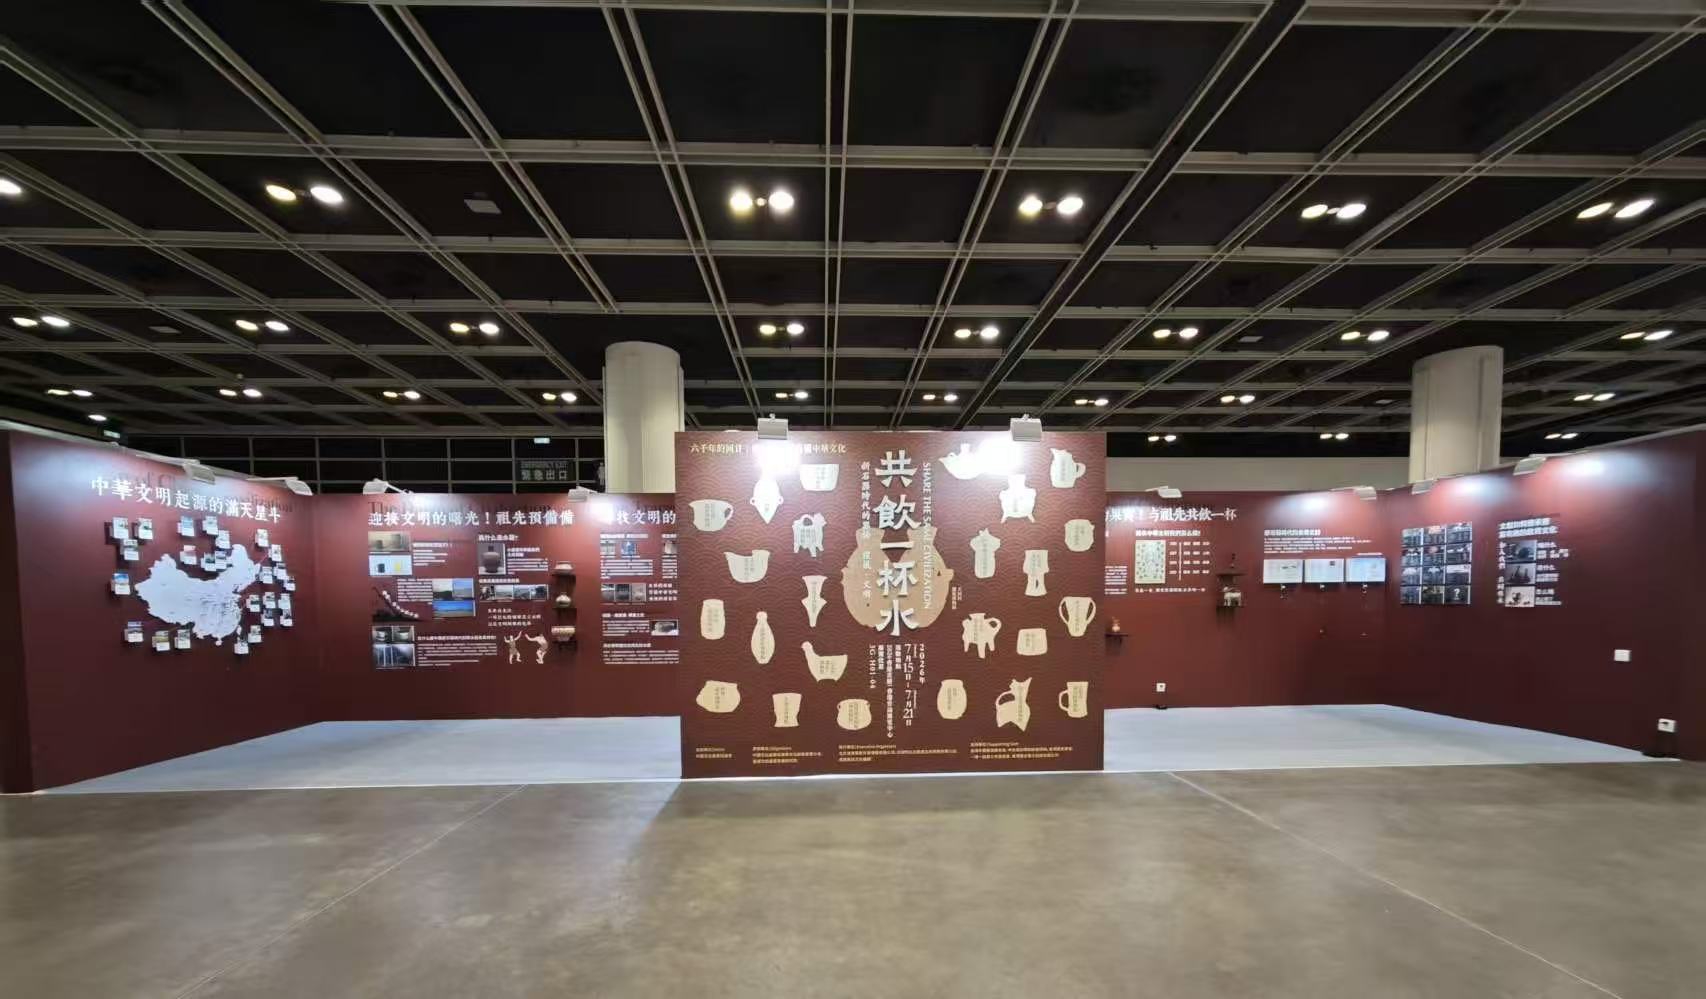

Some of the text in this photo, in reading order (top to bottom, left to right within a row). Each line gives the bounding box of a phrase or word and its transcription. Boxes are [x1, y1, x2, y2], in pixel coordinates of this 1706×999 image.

[923, 462, 932, 494] SHARE
[91, 476, 281, 523] 中華文明起源的滿天星斗
[923, 496, 932, 514] THE
[603, 510, 677, 525] 找文明的
[874, 450, 920, 636] 共飲一杯水
